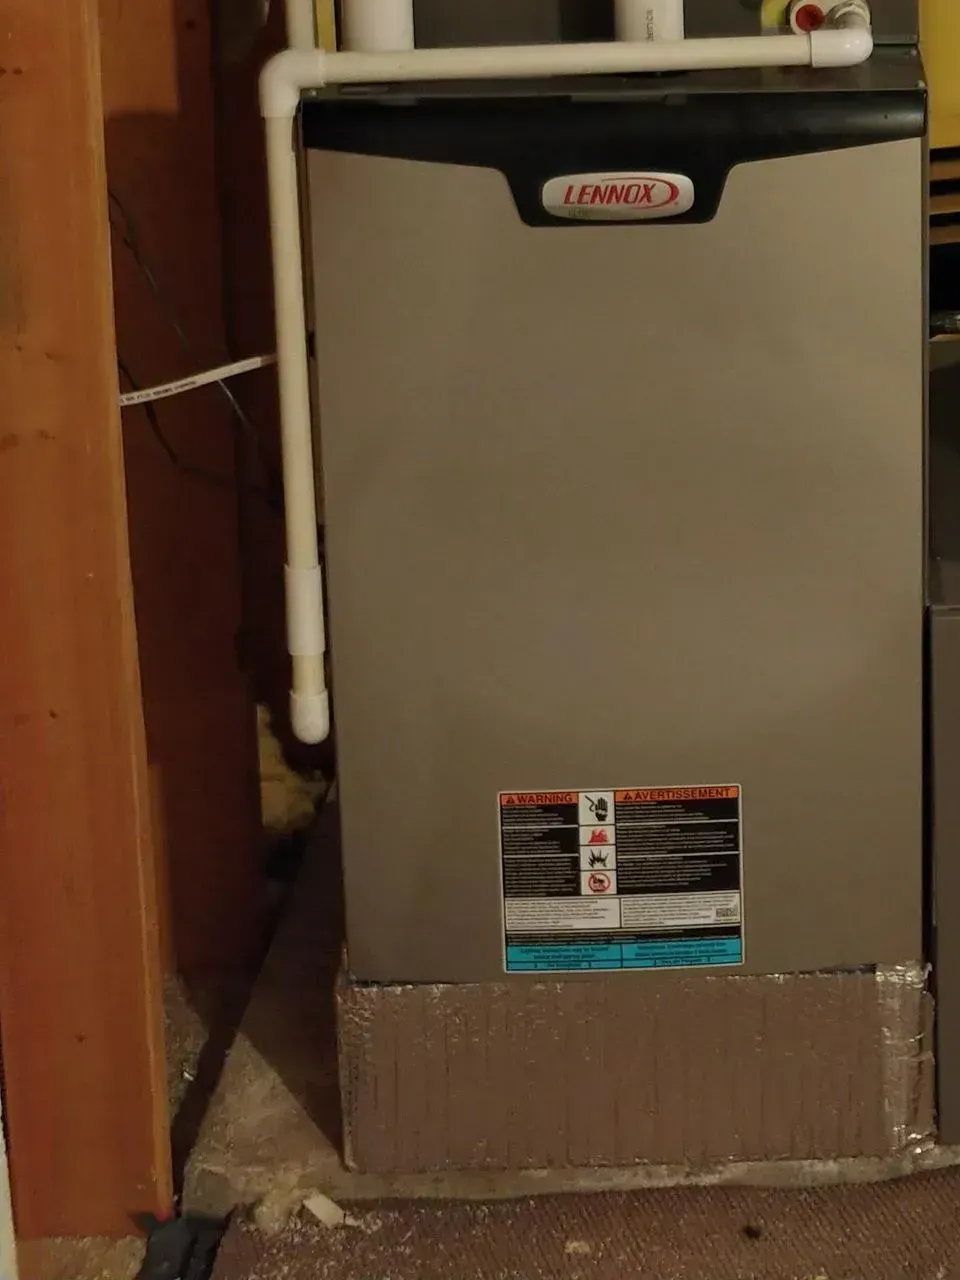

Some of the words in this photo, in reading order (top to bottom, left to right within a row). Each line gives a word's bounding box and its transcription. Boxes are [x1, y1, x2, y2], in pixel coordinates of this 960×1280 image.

[563, 183, 657, 205] LENNOX
[517, 793, 573, 805] WARNING
[634, 787, 731, 802] AVERTISSEMENT
